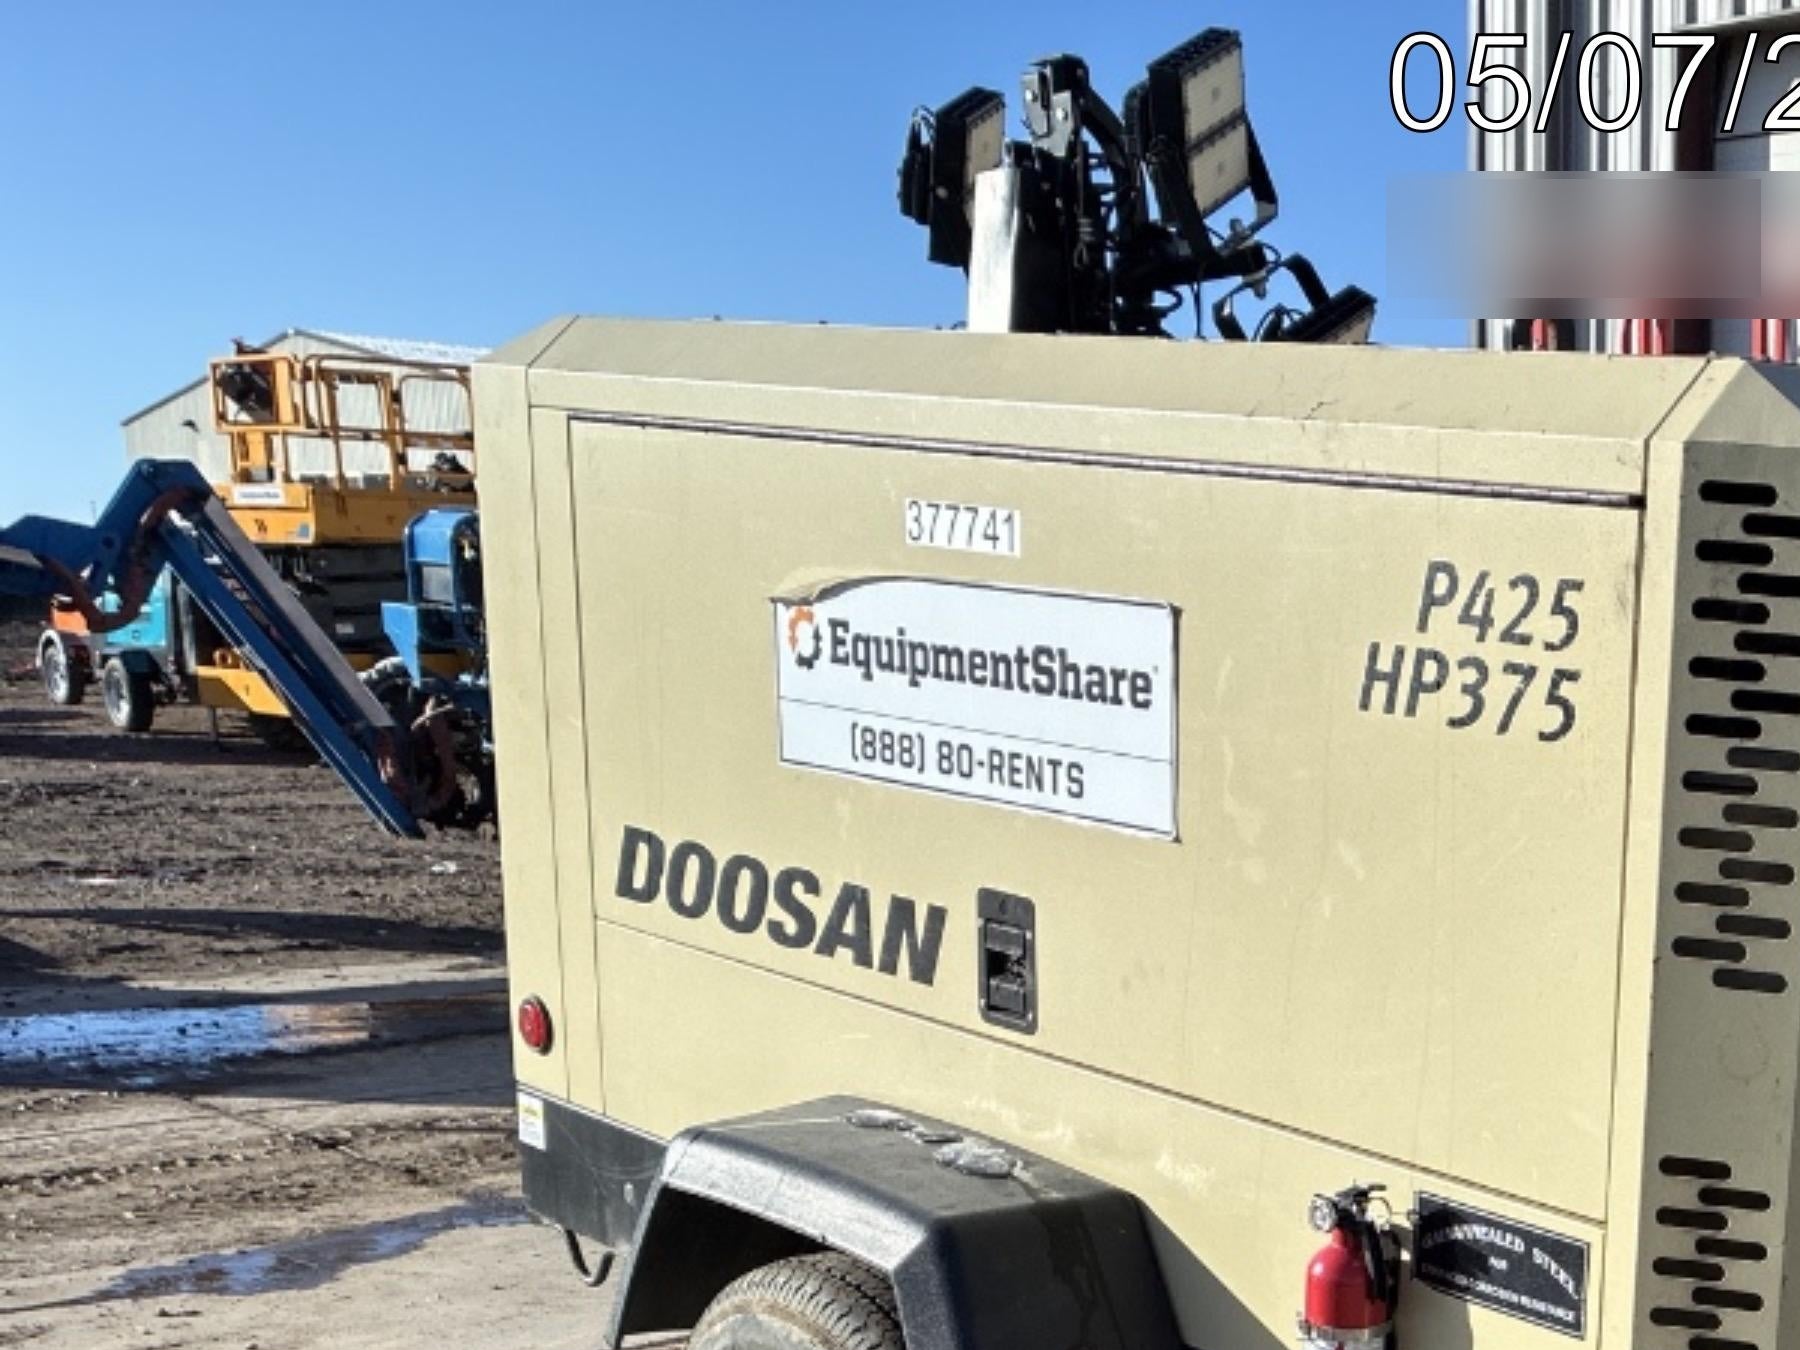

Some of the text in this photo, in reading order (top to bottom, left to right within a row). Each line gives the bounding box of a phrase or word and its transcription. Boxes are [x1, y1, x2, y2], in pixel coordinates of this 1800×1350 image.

[907, 500, 1017, 553] 377741
[1415, 560, 1585, 651] P425
[827, 616, 1154, 710] EquipmentShare
[1358, 641, 1582, 742] HP375
[850, 721, 1085, 800] (888) 80-RENTS
[615, 824, 949, 987] DOOSAN
